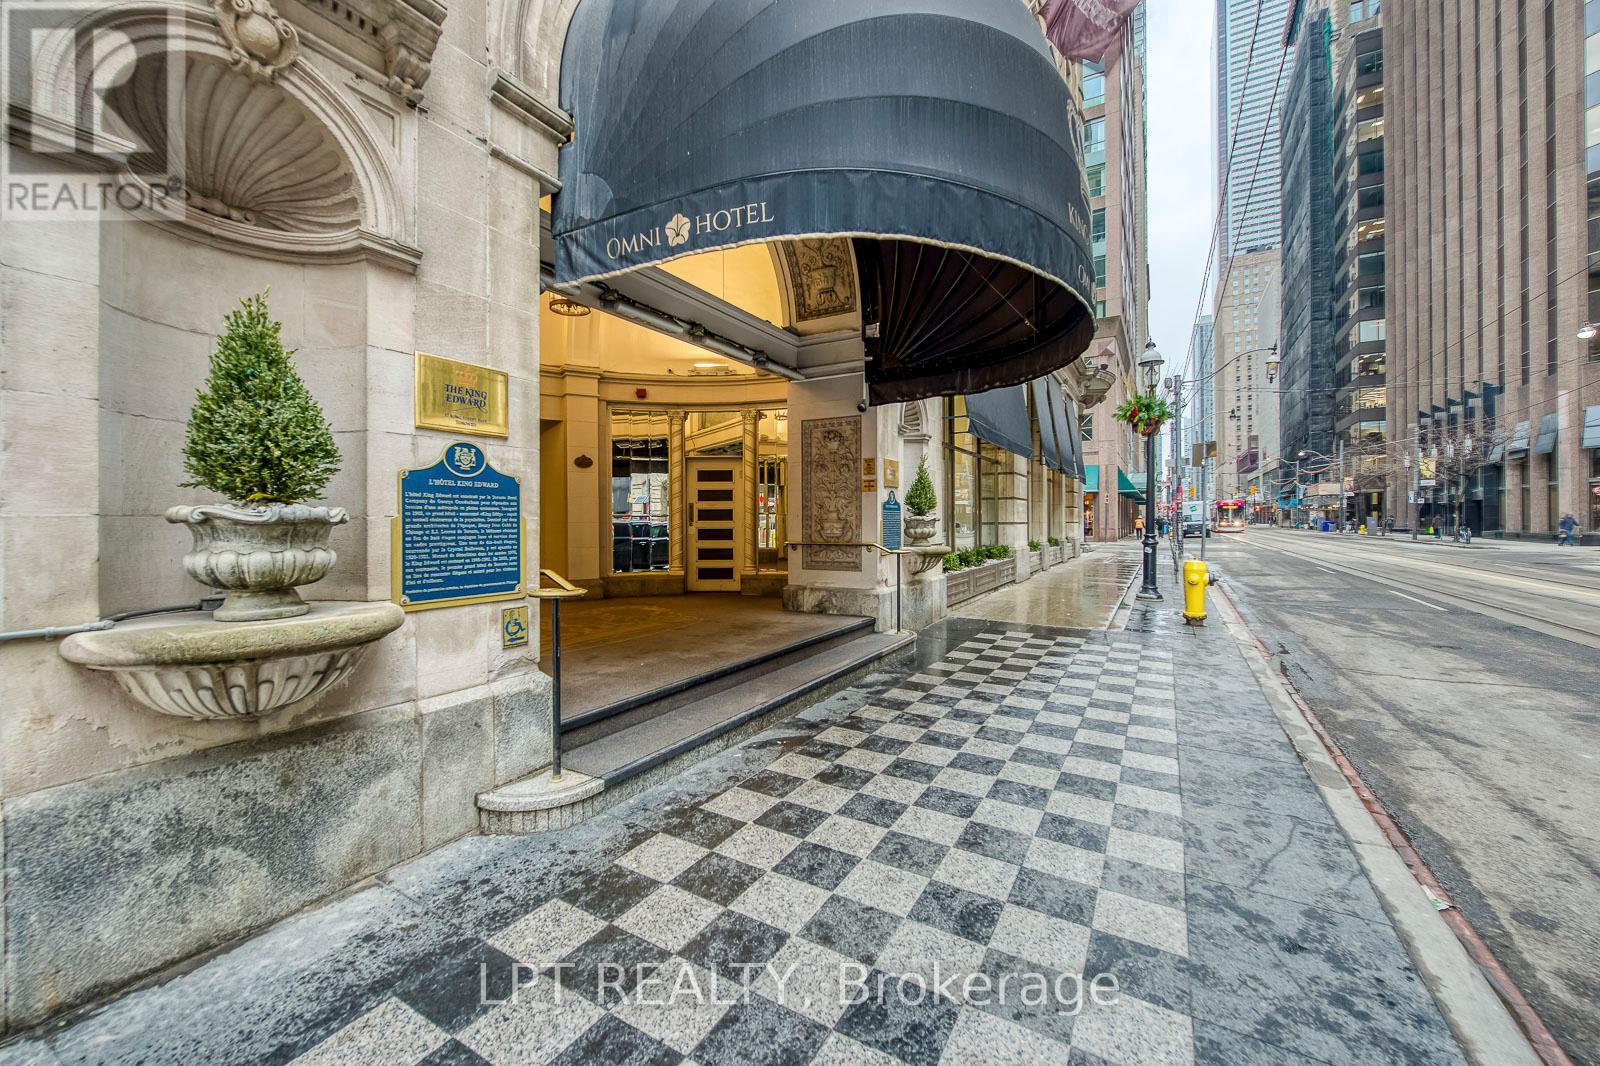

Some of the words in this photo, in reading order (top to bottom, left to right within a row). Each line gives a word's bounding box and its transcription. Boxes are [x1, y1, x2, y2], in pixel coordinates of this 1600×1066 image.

[606, 227, 662, 260] OMNI
[695, 202, 775, 235] HOTEL
[444, 384, 464, 394] THE
[465, 387, 487, 401] KING
[446, 394, 488, 412] EDWARD
[457, 480, 473, 488] KING
[474, 481, 499, 489] EDWARD
